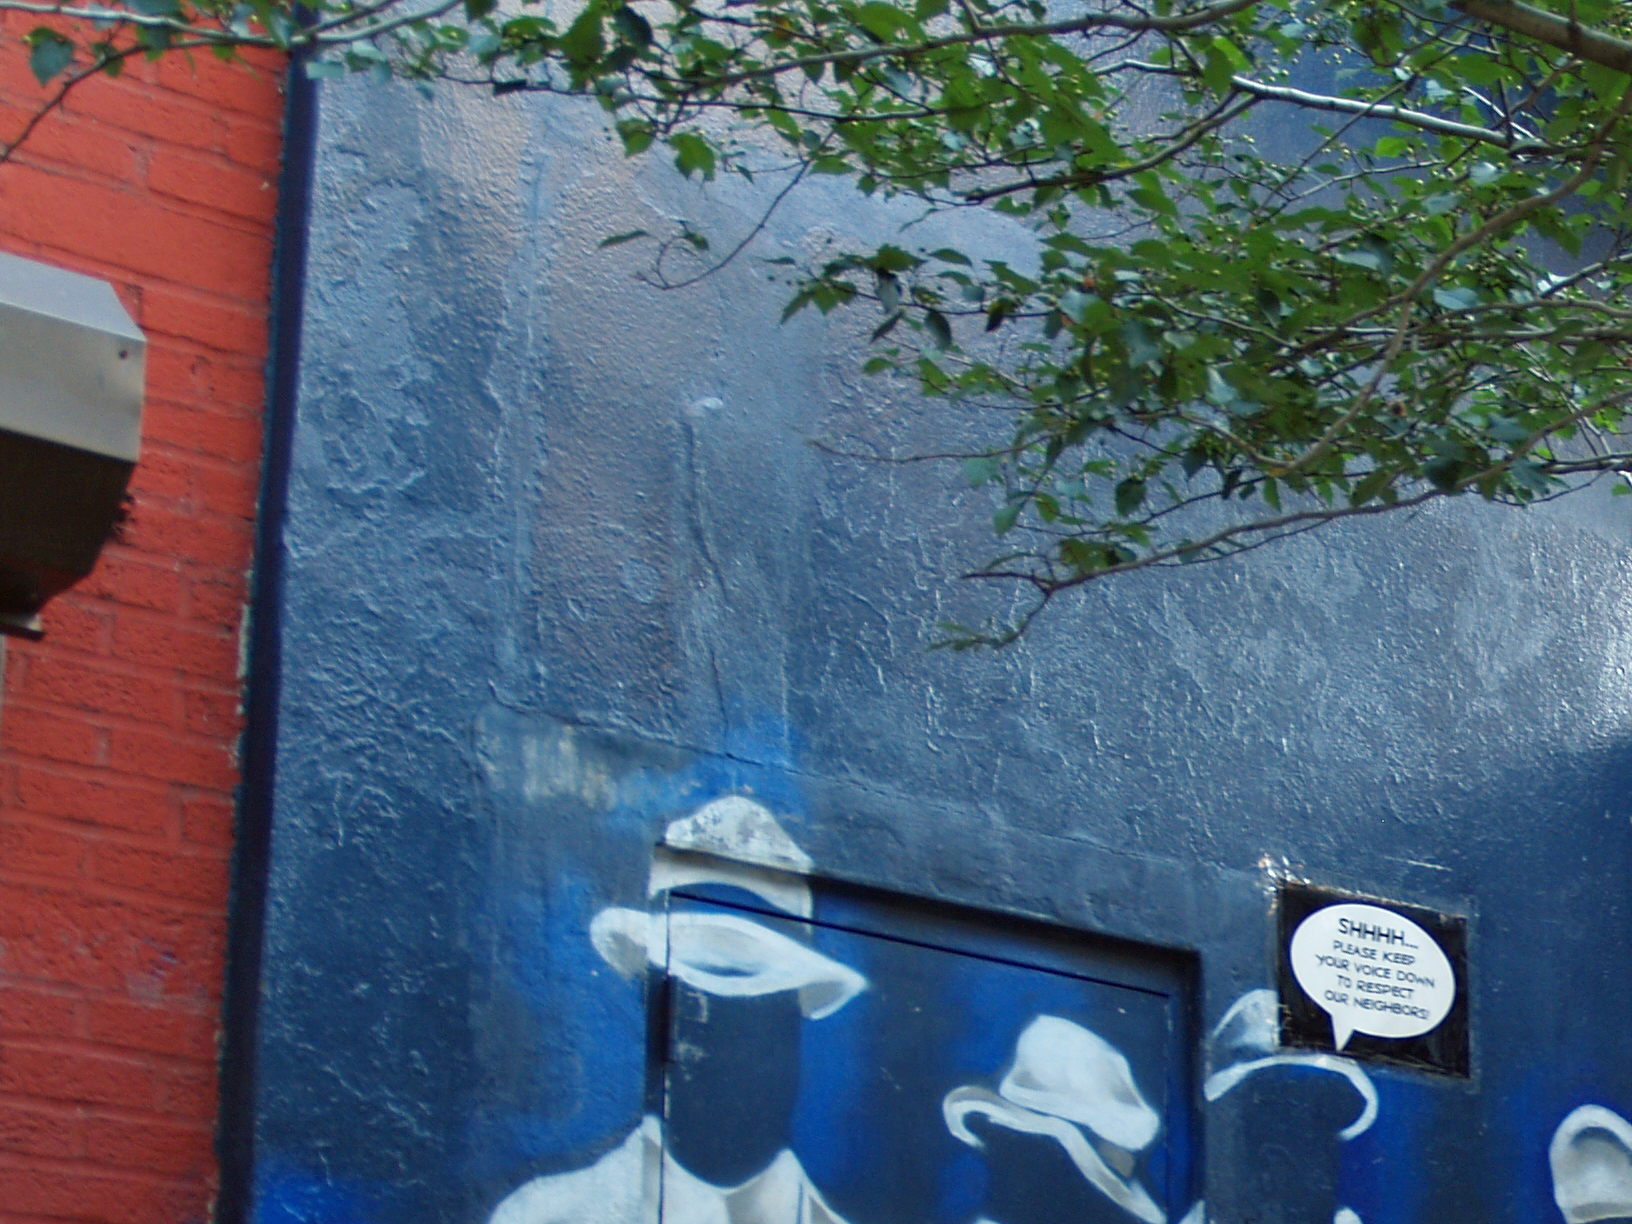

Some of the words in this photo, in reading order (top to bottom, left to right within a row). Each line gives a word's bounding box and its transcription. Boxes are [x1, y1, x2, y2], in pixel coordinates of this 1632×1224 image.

[1333, 940, 1377, 960] PLEASE
[1382, 950, 1416, 966] KEEP
[1315, 953, 1350, 971] YOUR
[1354, 963, 1391, 980] VOICE
[1397, 970, 1435, 988] DOWN
[1324, 989, 1350, 1006] OUR
[1337, 974, 1353, 989] TO
[1357, 979, 1415, 1000] RESPECT
